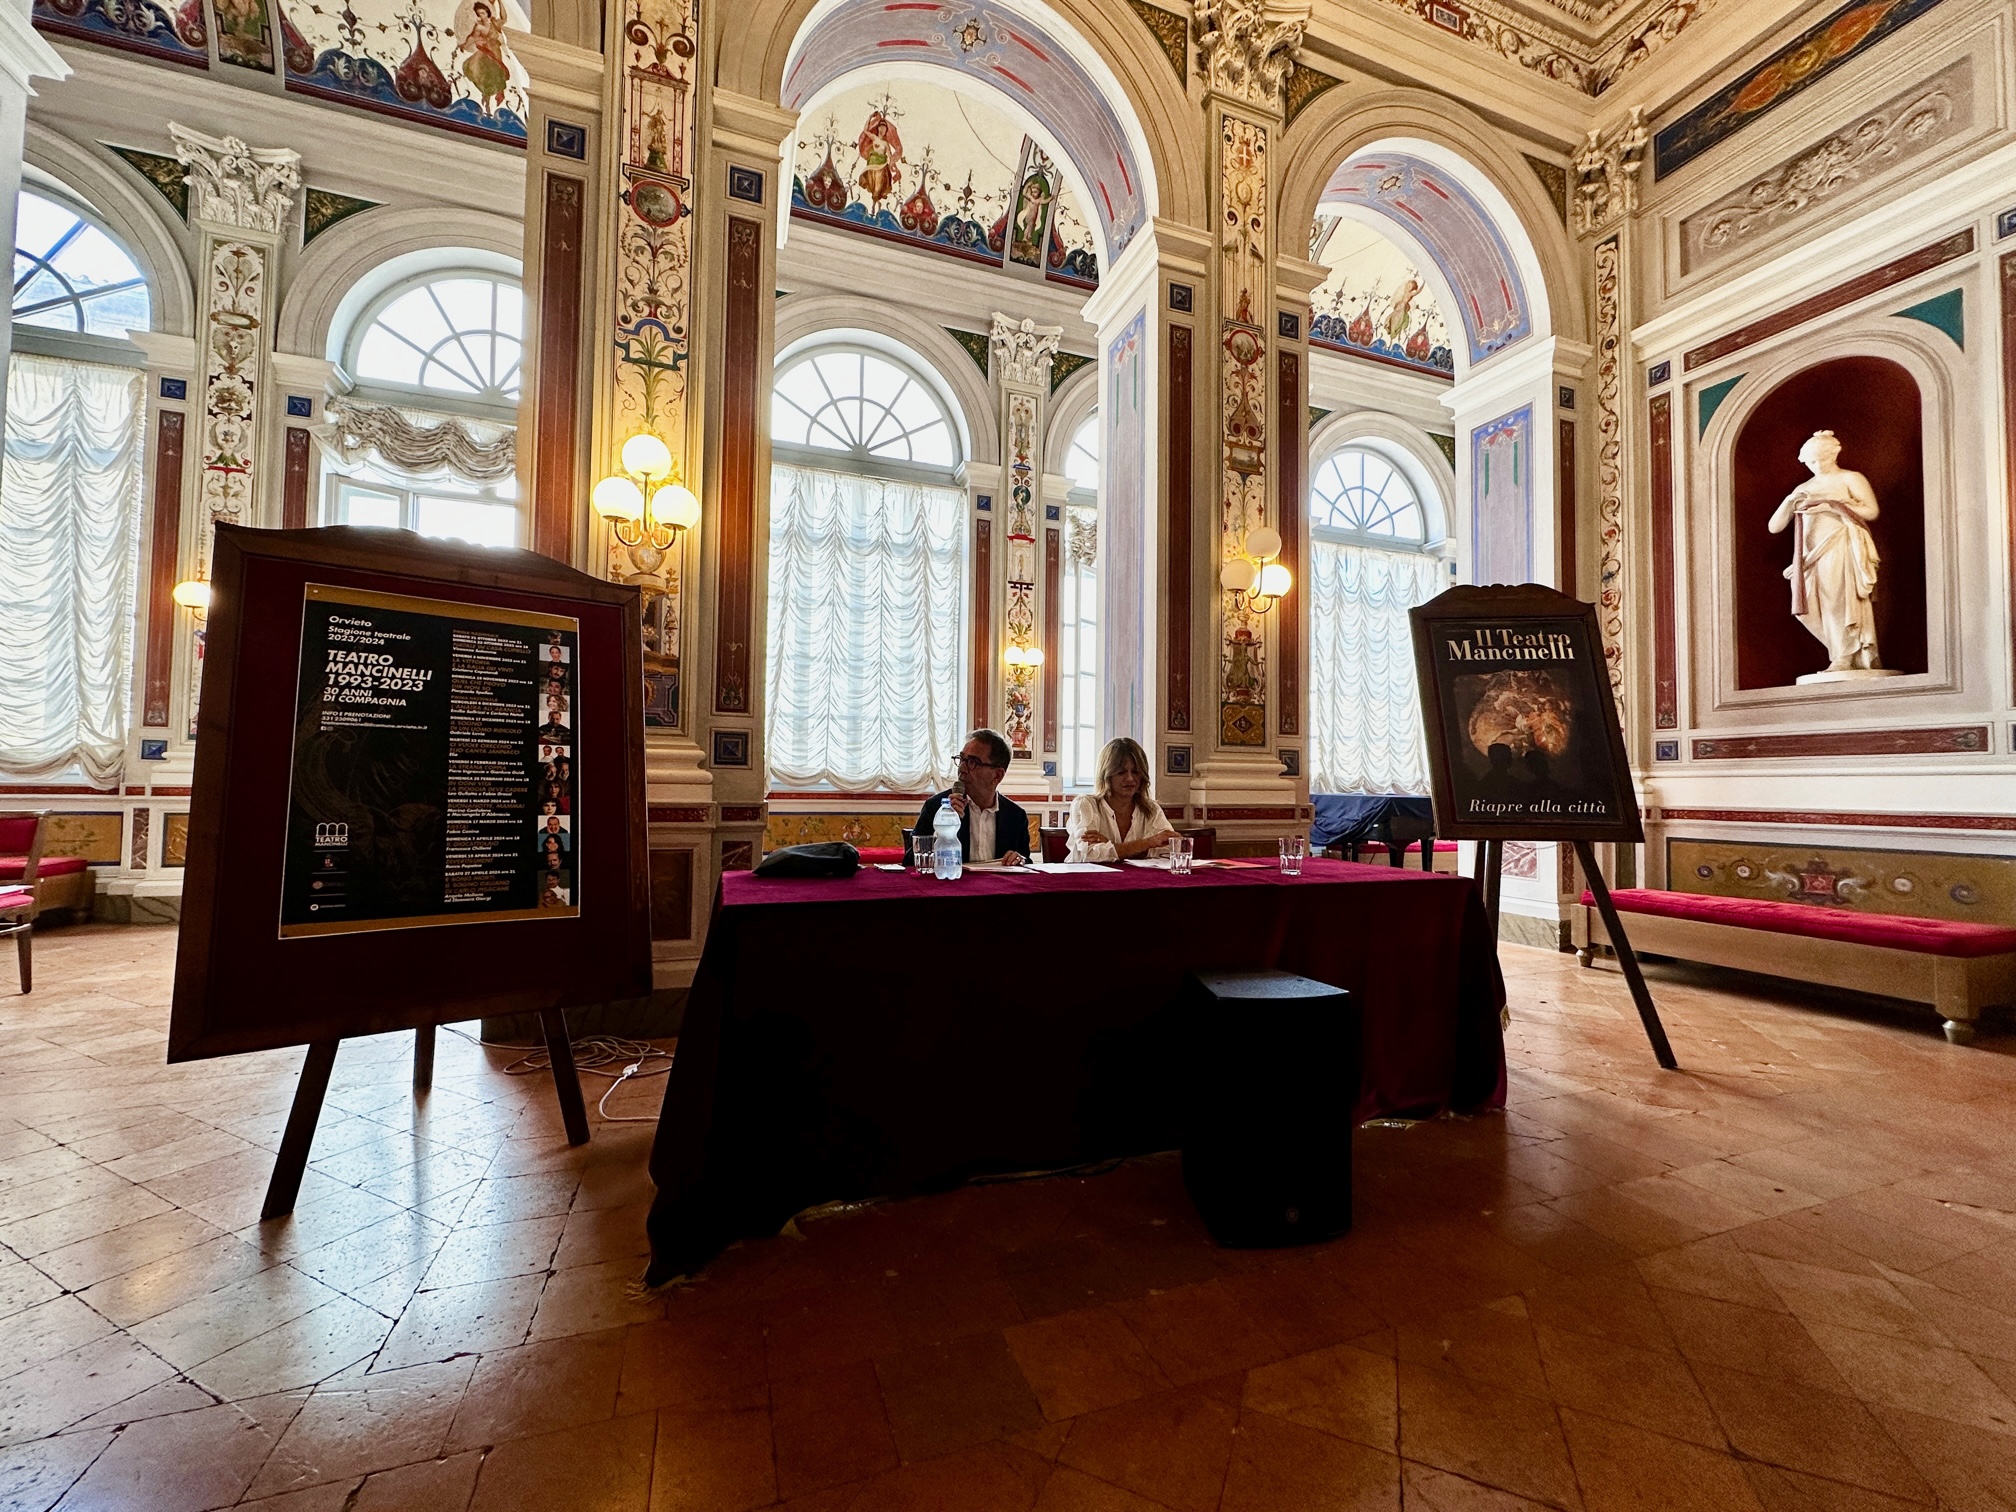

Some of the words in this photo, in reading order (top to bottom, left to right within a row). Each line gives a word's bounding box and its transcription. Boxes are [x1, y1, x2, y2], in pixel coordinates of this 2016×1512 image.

[329, 616, 372, 627] Orvieto
[328, 626, 371, 636] Stagione
[374, 631, 411, 640] teatrale
[328, 634, 385, 645] 2023/2024
[1475, 629, 1493, 646] Il
[1496, 629, 1571, 646] Teatro
[328, 650, 393, 665] TEATRO
[1447, 640, 1575, 660] Mancinelli
[325, 662, 432, 680] MANCINELLI
[328, 674, 424, 691] 1993-2023
[338, 696, 406, 706] COMPAGNIA
[1469, 799, 1523, 816] Riapre
[1529, 800, 1561, 813] alla
[1568, 800, 1607, 814] città
